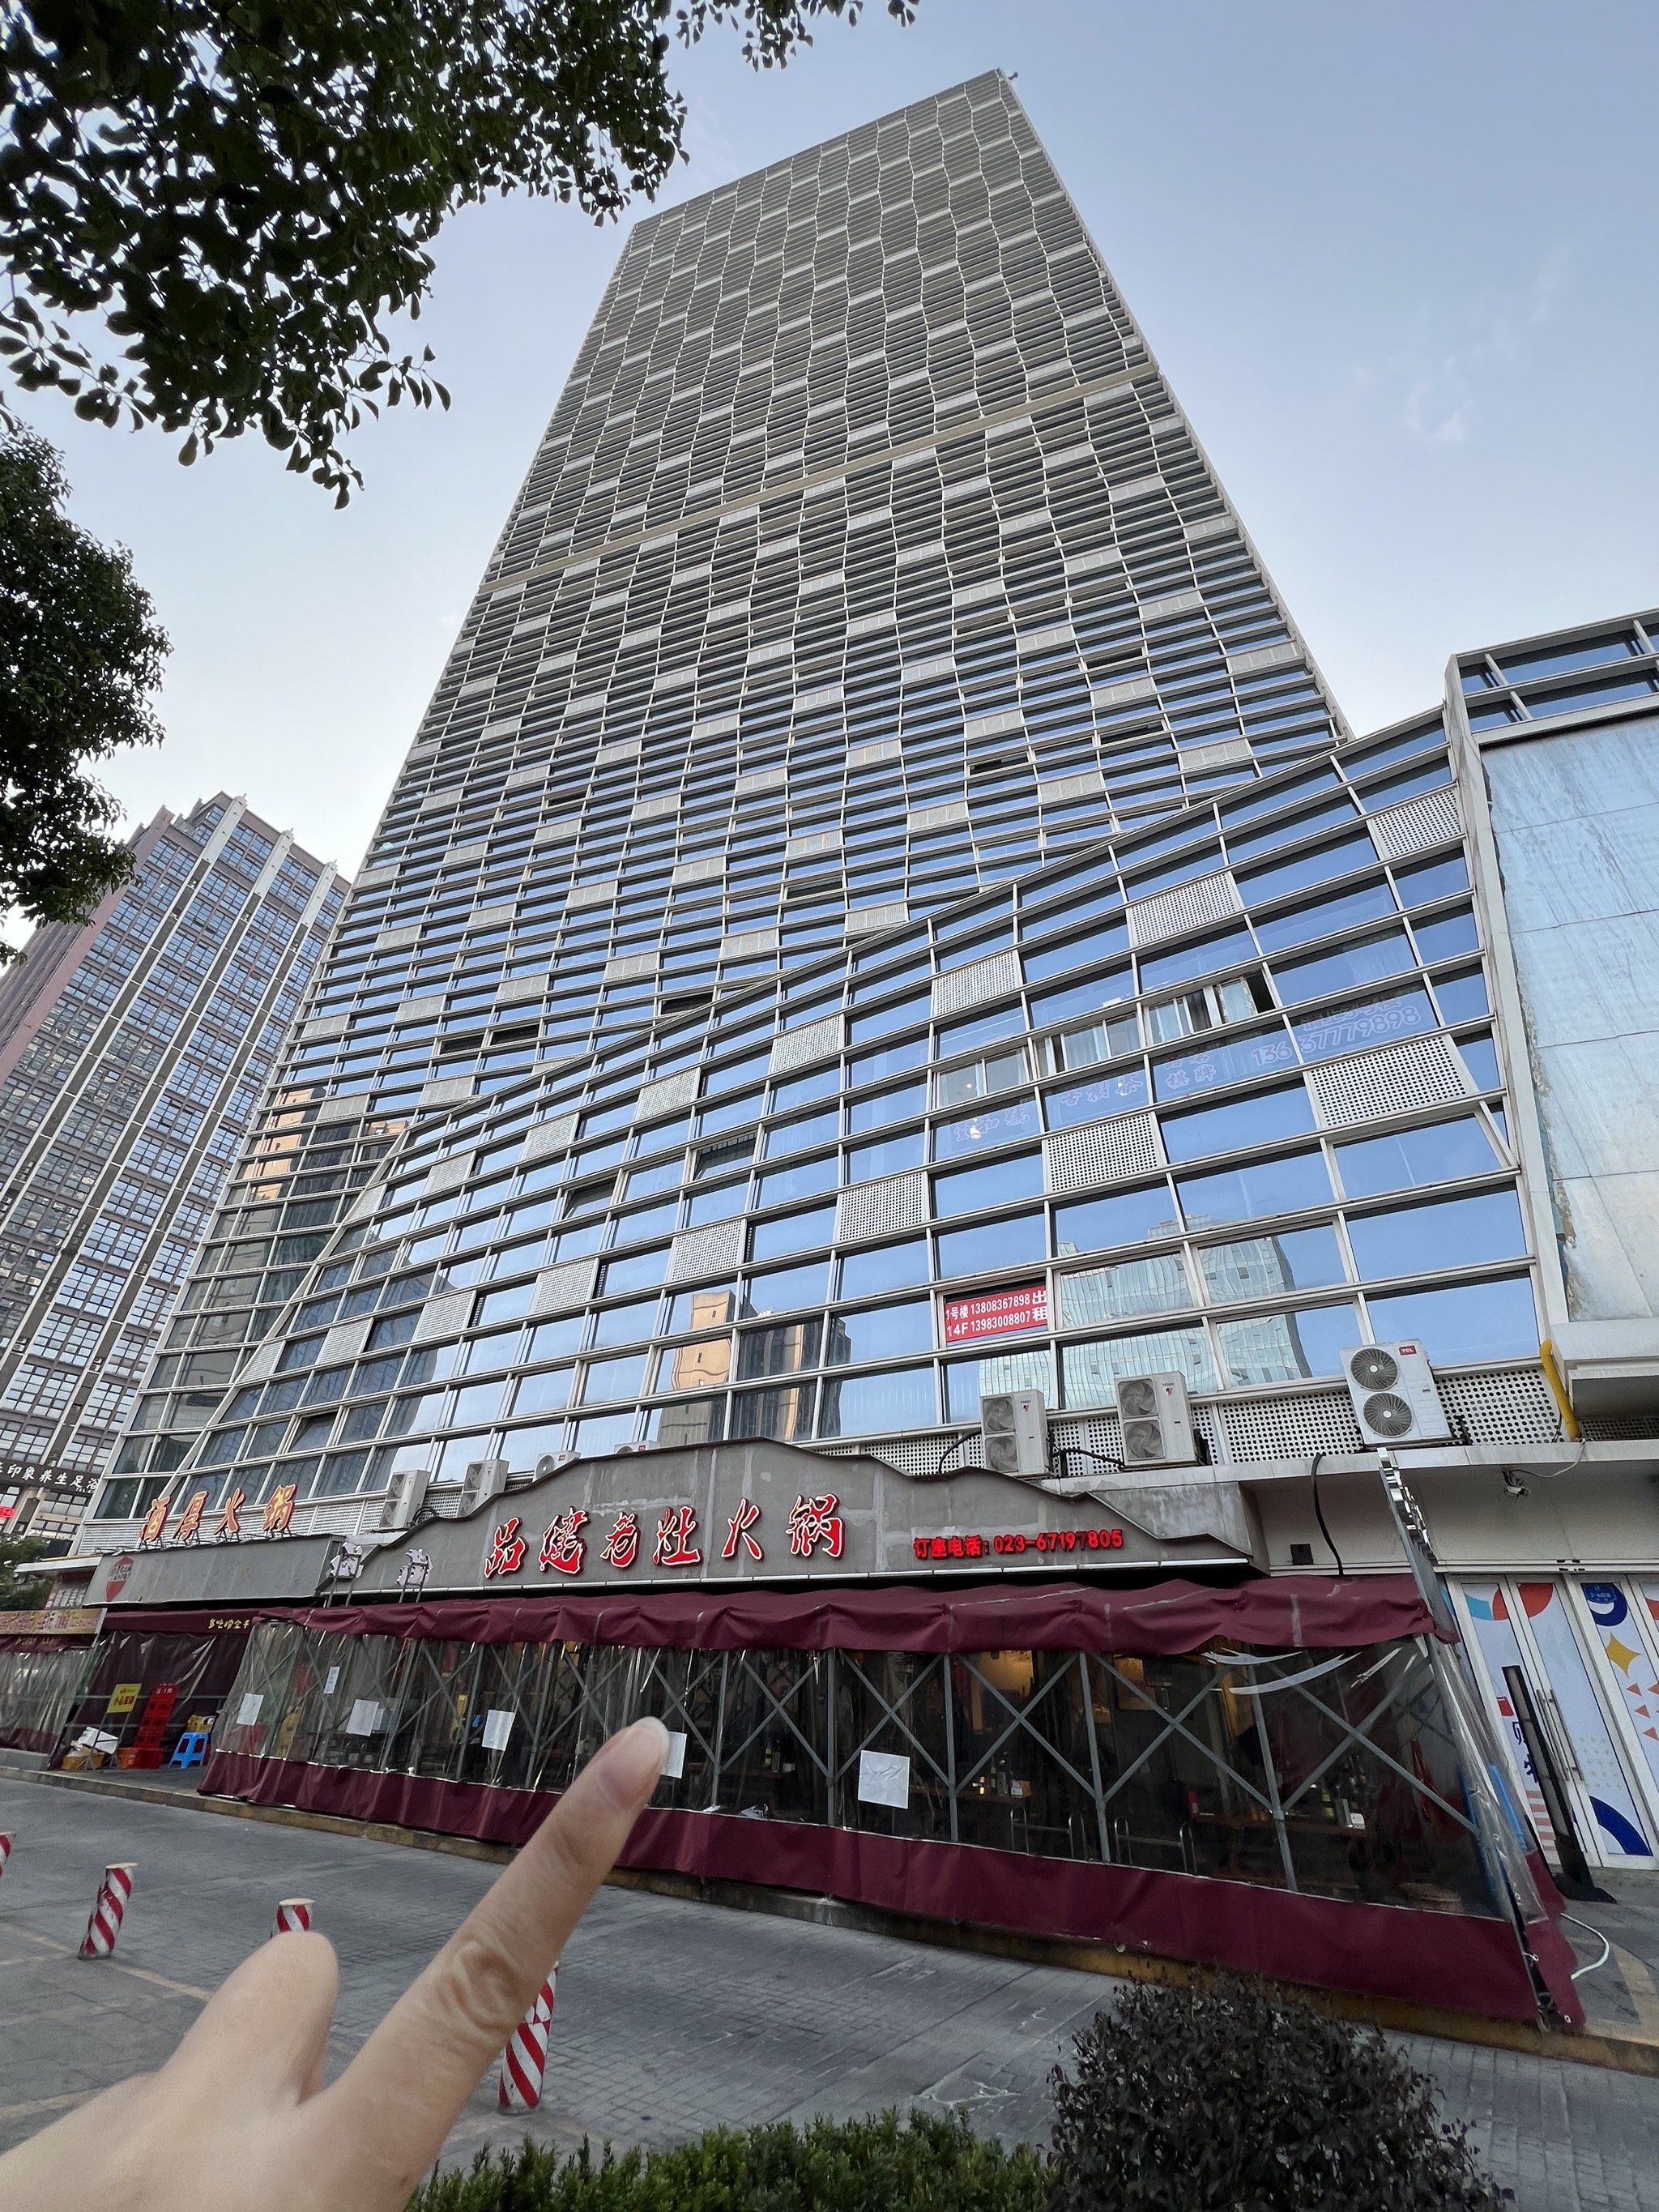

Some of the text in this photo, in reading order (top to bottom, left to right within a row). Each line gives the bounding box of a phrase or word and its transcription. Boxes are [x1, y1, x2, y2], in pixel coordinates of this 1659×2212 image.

[945, 1293, 1030, 1321] 1号楼 13808367898
[1032, 1289, 1047, 1322] 出租
[946, 1310, 1030, 1337] 14F 13983008807
[0, 1460, 100, 1491] 印象养生足浴
[993, 1528, 1124, 1554] 023-67197805
